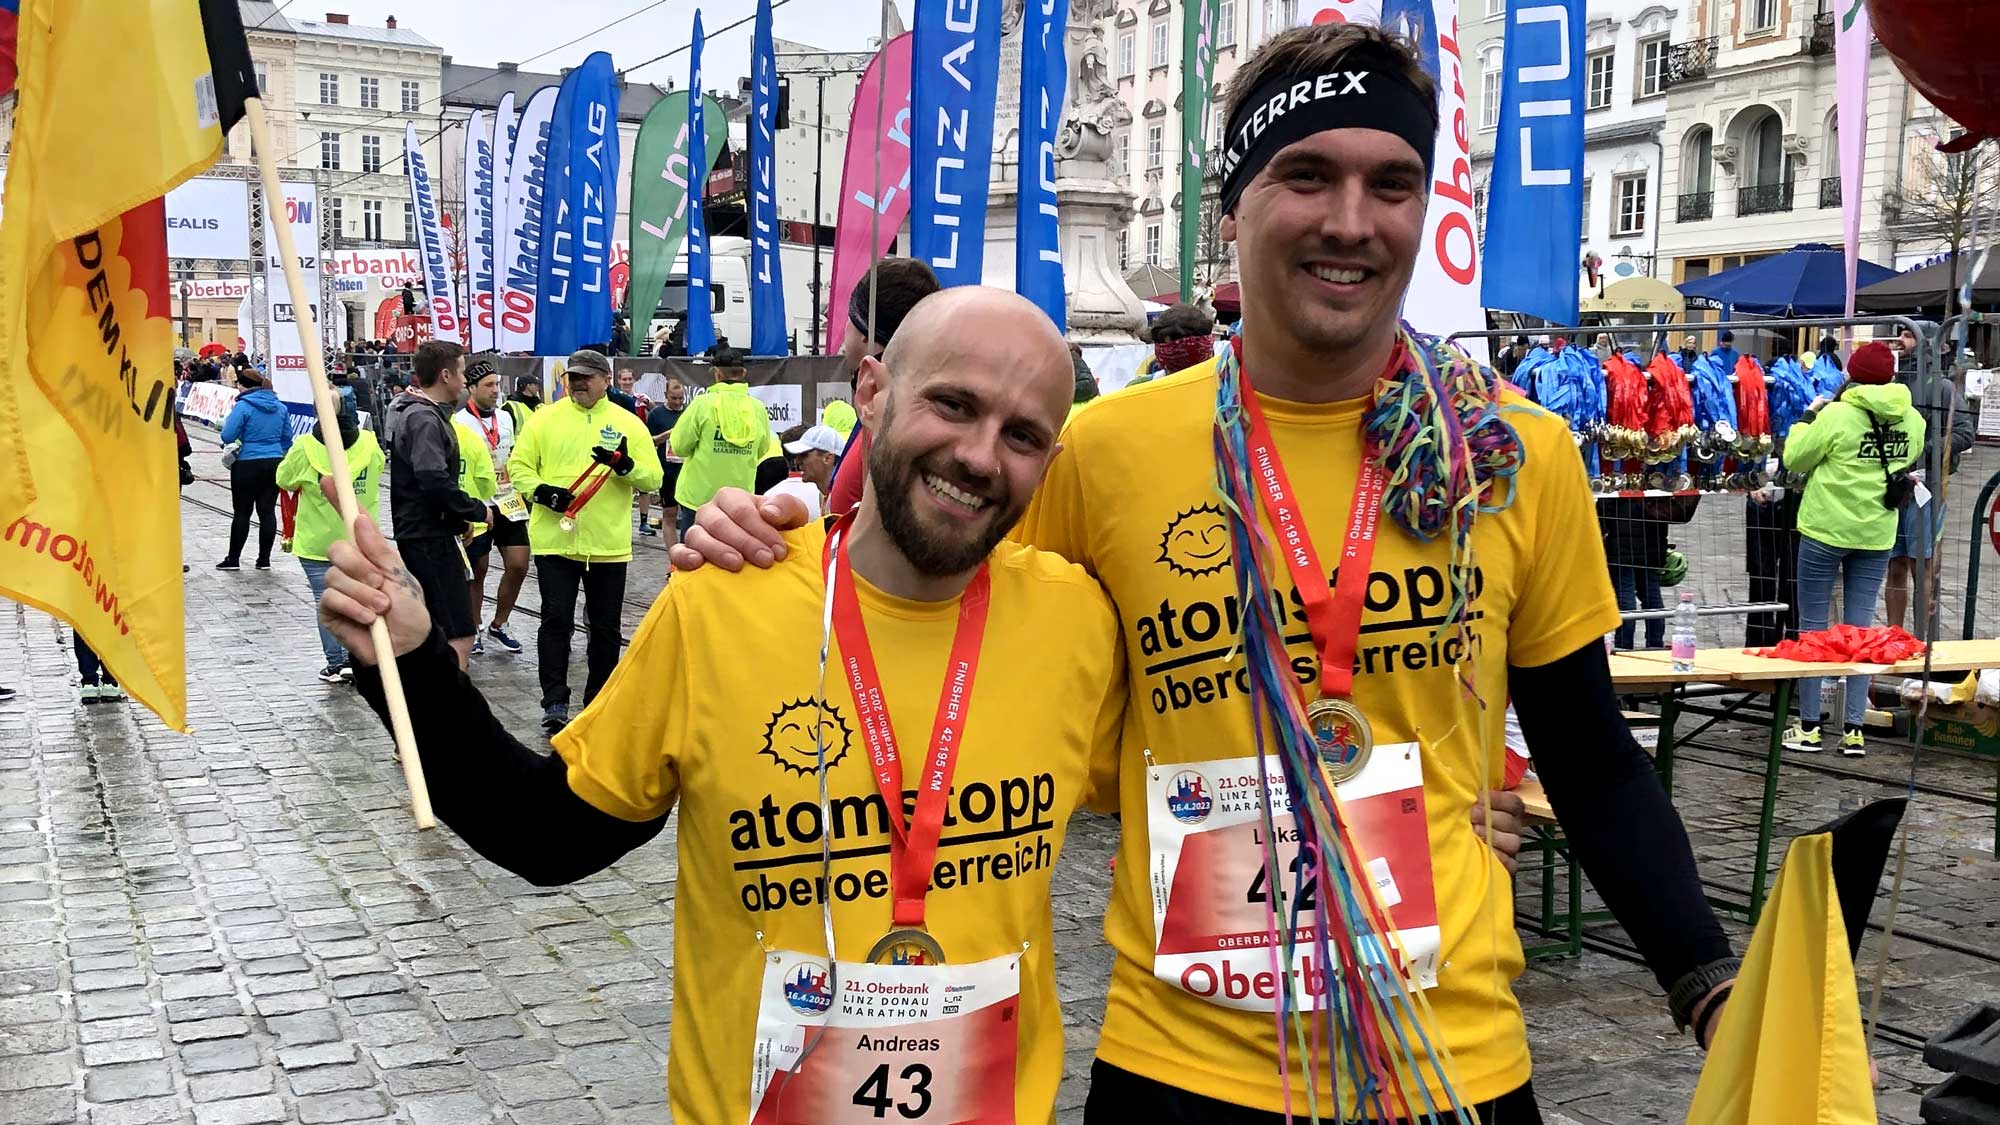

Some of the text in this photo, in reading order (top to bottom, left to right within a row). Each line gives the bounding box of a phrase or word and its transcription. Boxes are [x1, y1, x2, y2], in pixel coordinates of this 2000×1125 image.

[1240, 71, 1370, 150] TERREX
[278, 358, 304, 367] ORF
[1255, 446, 1310, 567] FINISHER 42,195 KM
[1350, 490, 1368, 539] Oberbank
[1362, 492, 1380, 541] Marathon
[849, 656, 864, 690] Donau
[858, 692, 870, 715] Linz
[864, 717, 885, 766] Oberbank
[869, 687, 897, 762] Marathon 2023
[930, 661, 969, 791] FINISHER 42,195 KM
[1171, 801, 1211, 813] 16.4.2023
[1220, 791, 1248, 801] LINZ
[786, 991, 831, 1006] 16.4.2023
[842, 1005, 928, 1018] MARATHON
[843, 995, 929, 1006] LINZ DONAU
[856, 1035, 940, 1052] Andreas
[852, 1063, 933, 1119] 43
